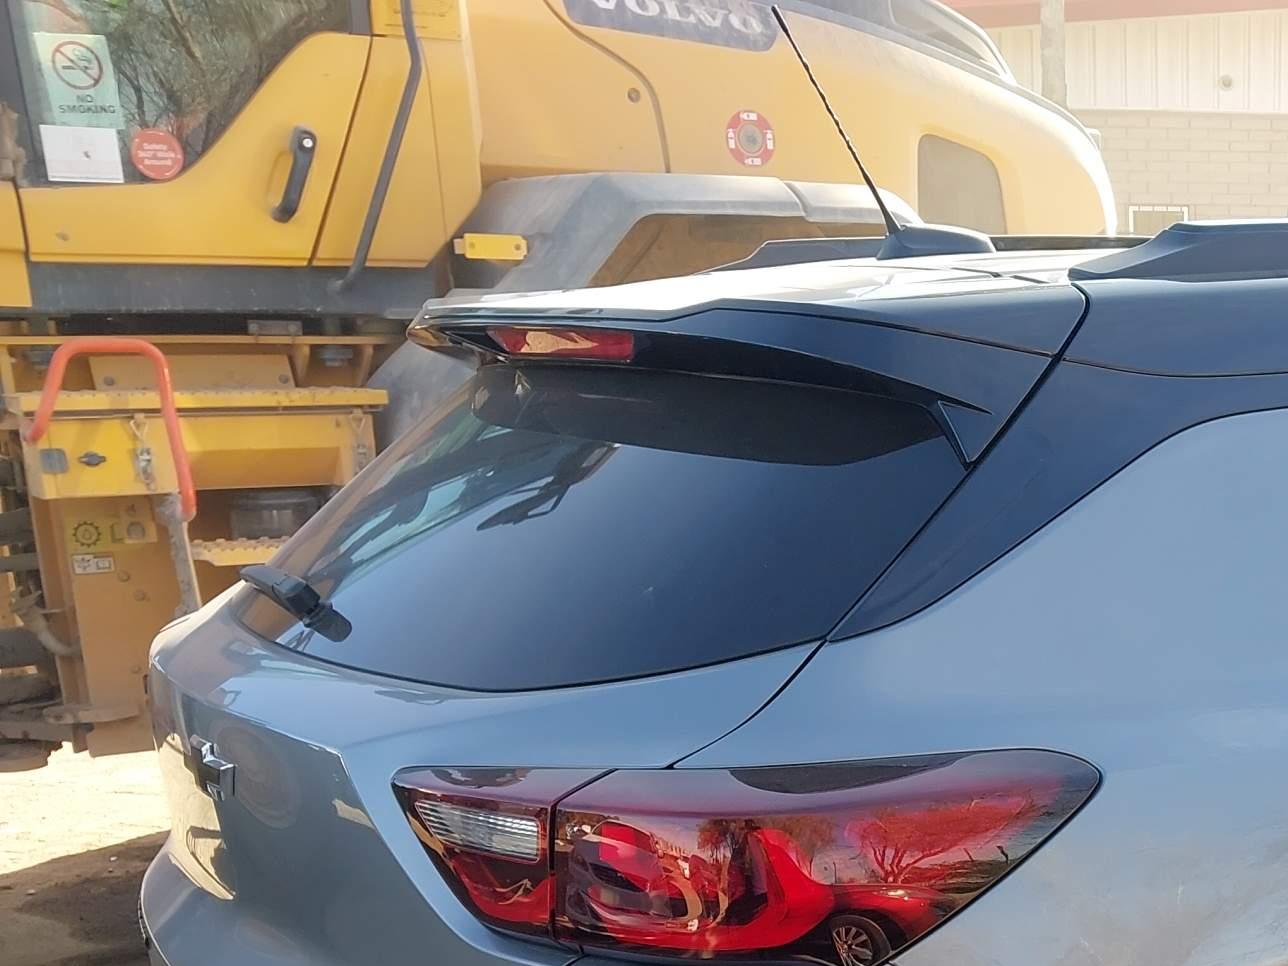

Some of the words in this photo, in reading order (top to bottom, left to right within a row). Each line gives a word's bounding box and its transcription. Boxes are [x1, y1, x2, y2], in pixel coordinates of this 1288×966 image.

[590, 0, 763, 34] VOLVO
[76, 94, 94, 103] NO
[58, 104, 116, 114] SMOKING
